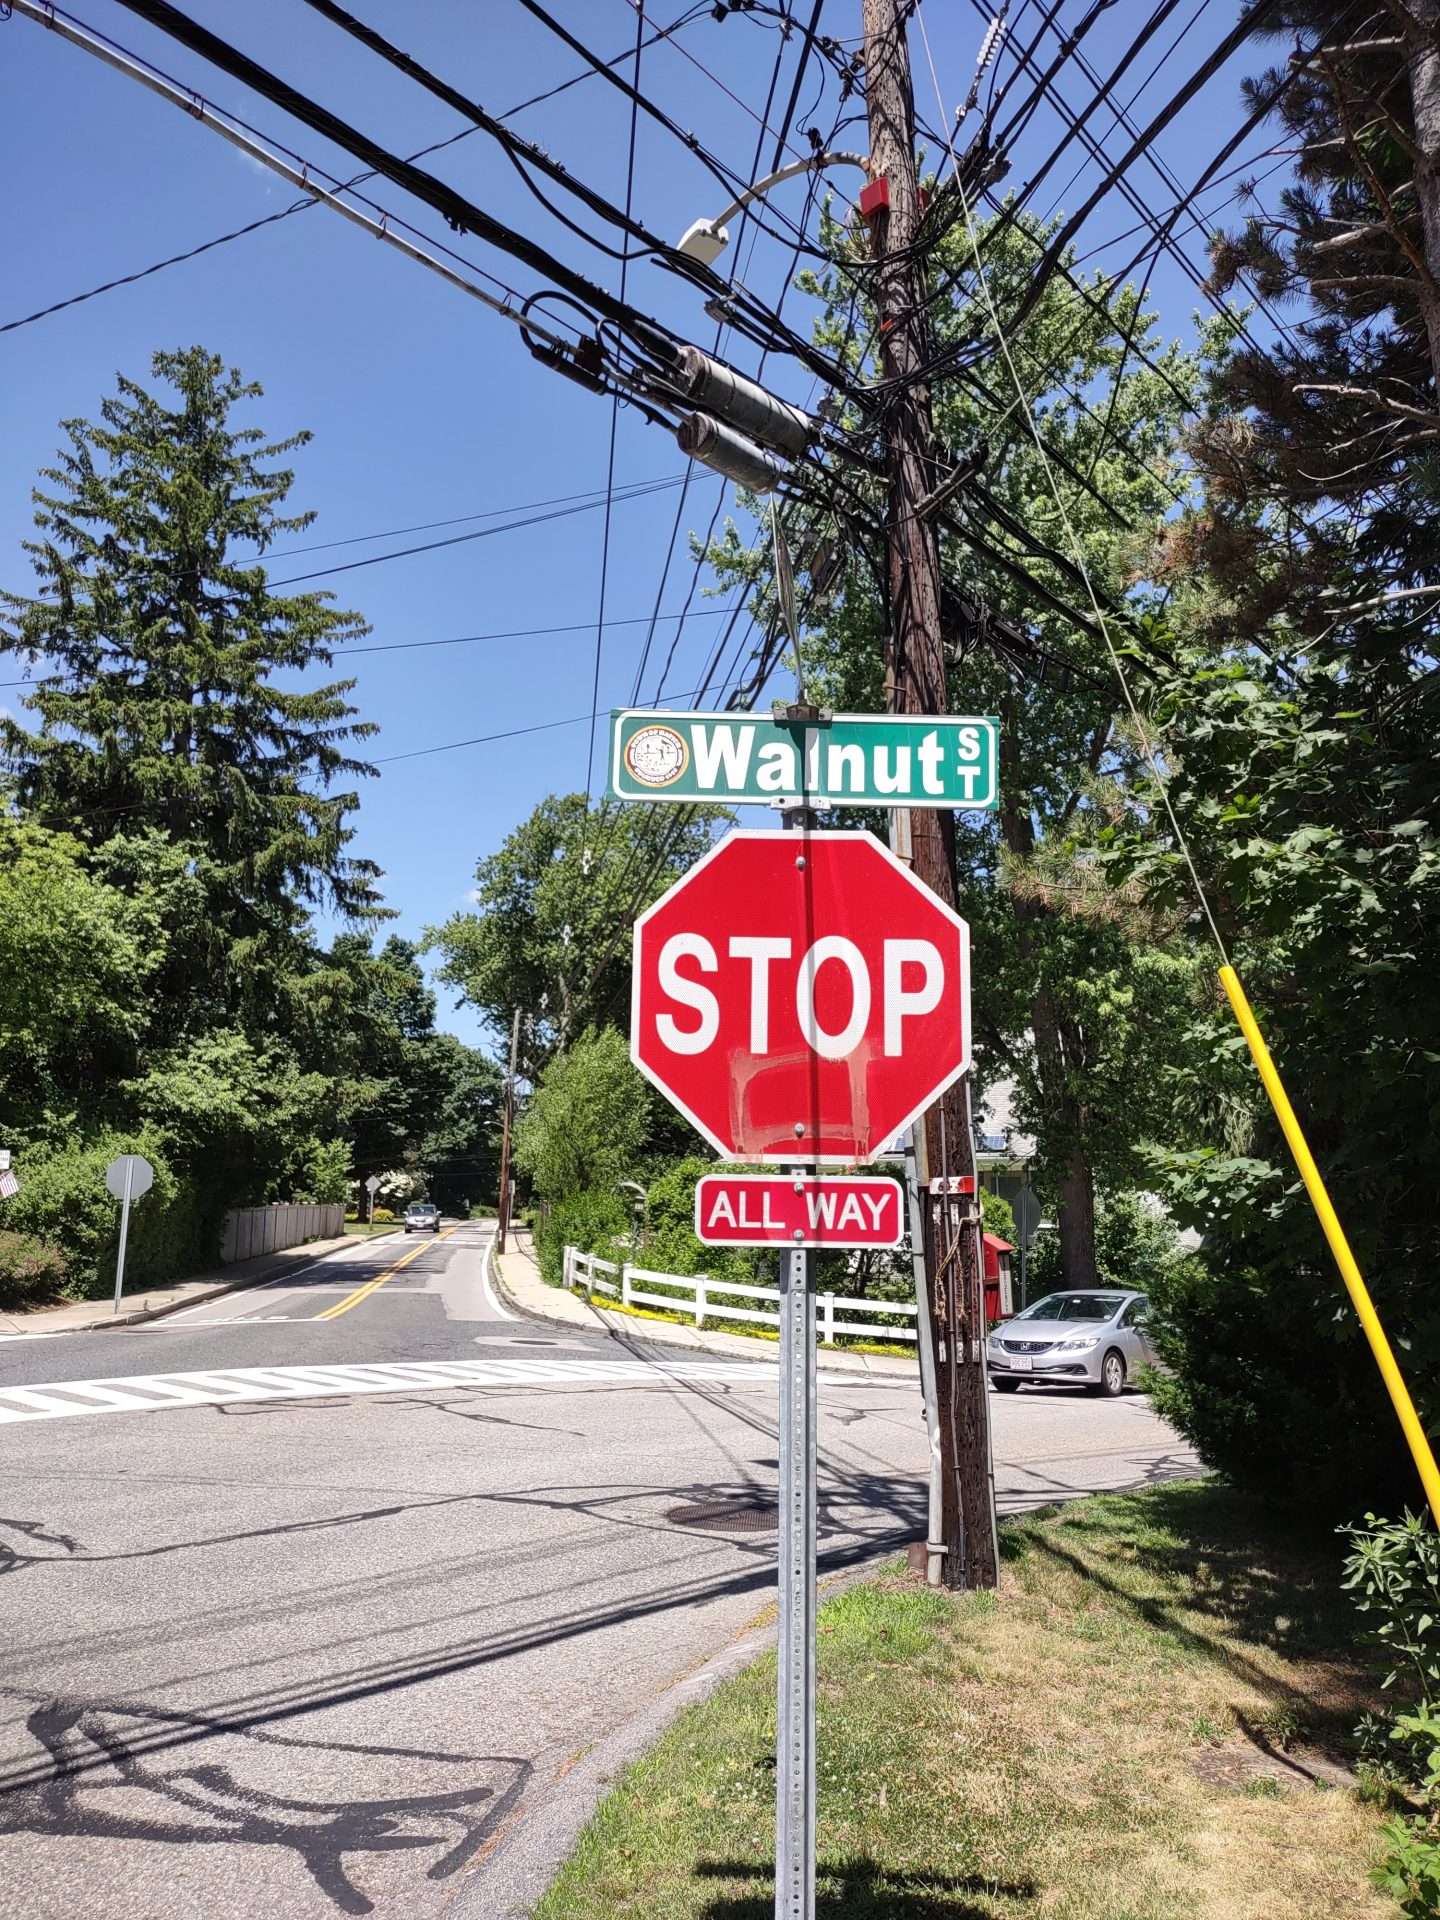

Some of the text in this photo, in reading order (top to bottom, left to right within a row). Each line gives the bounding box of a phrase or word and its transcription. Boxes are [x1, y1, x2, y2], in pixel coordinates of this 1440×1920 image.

[690, 724, 945, 794] Walnut
[655, 932, 945, 1058] STOP
[707, 1190, 892, 1231] ALL WAY
